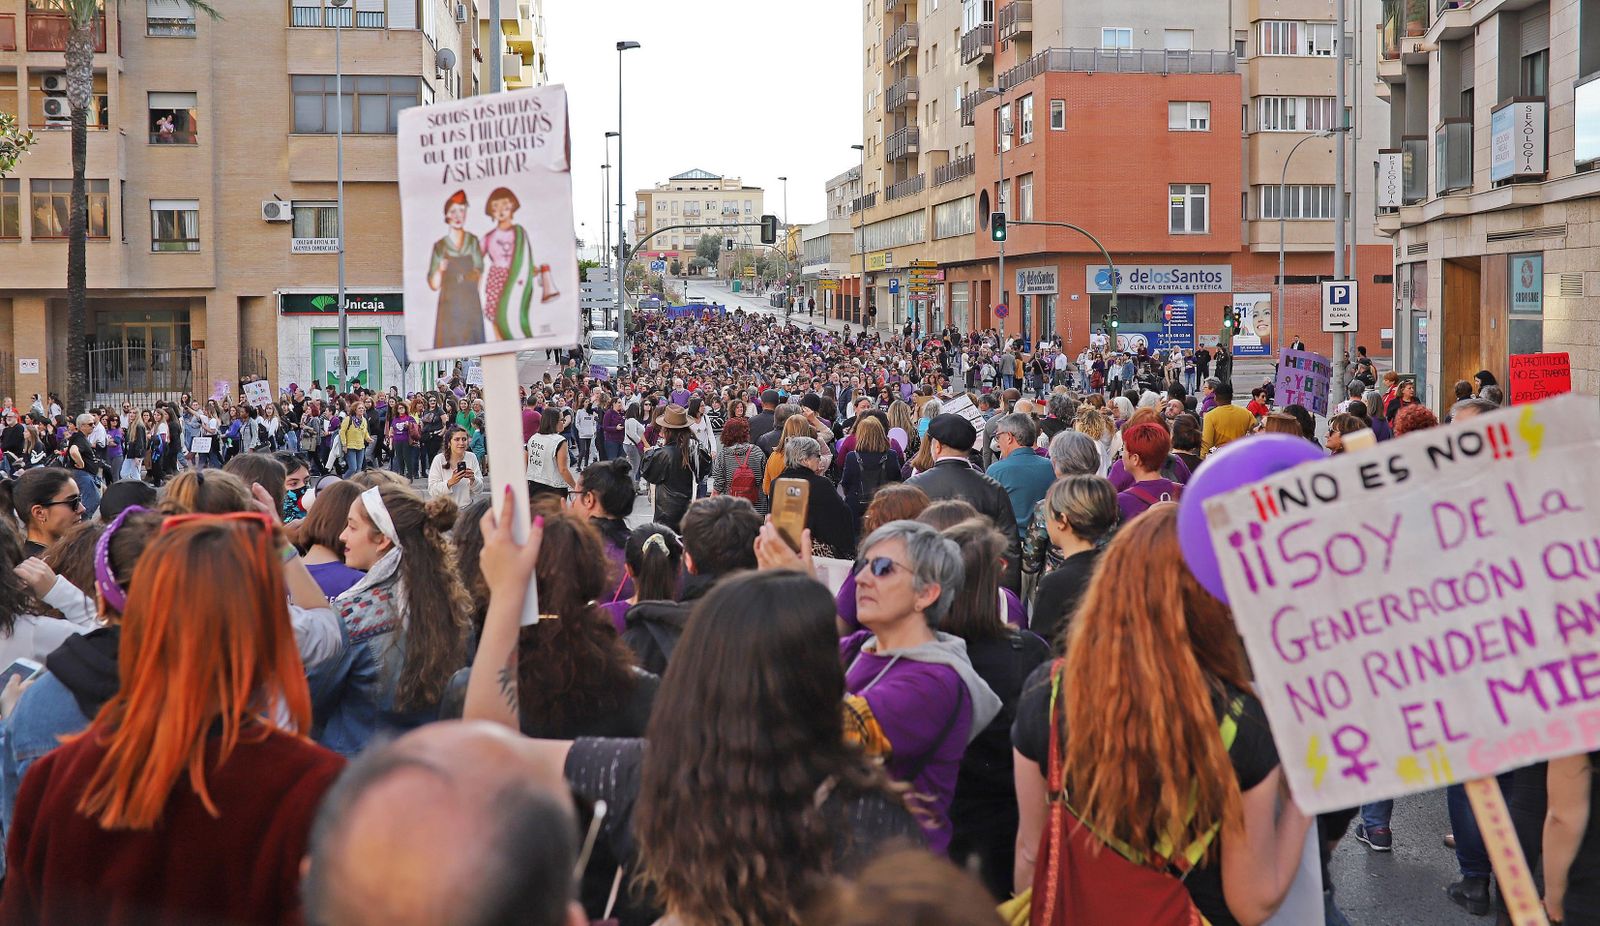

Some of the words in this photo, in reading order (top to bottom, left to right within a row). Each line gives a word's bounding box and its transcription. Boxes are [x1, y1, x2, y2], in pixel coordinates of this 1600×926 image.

[420, 133, 434, 147] DE
[442, 128, 466, 143] LAS
[470, 113, 552, 141] MILICIANAS
[427, 109, 469, 128] SOMOS
[473, 104, 495, 120] LAS
[423, 151, 445, 165] QUE
[454, 145, 472, 160] NO
[1523, 105, 1534, 172] SEXOLOGIA
[442, 152, 529, 184] ASESINAR
[1387, 155, 1396, 204] PSICOLOGIA
[1129, 268, 1222, 283] delosSantos
[1334, 287, 1346, 303] P
[1513, 371, 1528, 380] NO
[1360, 455, 1410, 490] ES
[1426, 423, 1514, 471] NO!!
[1431, 498, 1495, 551] DE
[1285, 670, 1351, 722] NO
[1362, 607, 1537, 697] RINDEN
[1401, 700, 1470, 752] EL
[1486, 652, 1600, 726] MIE
